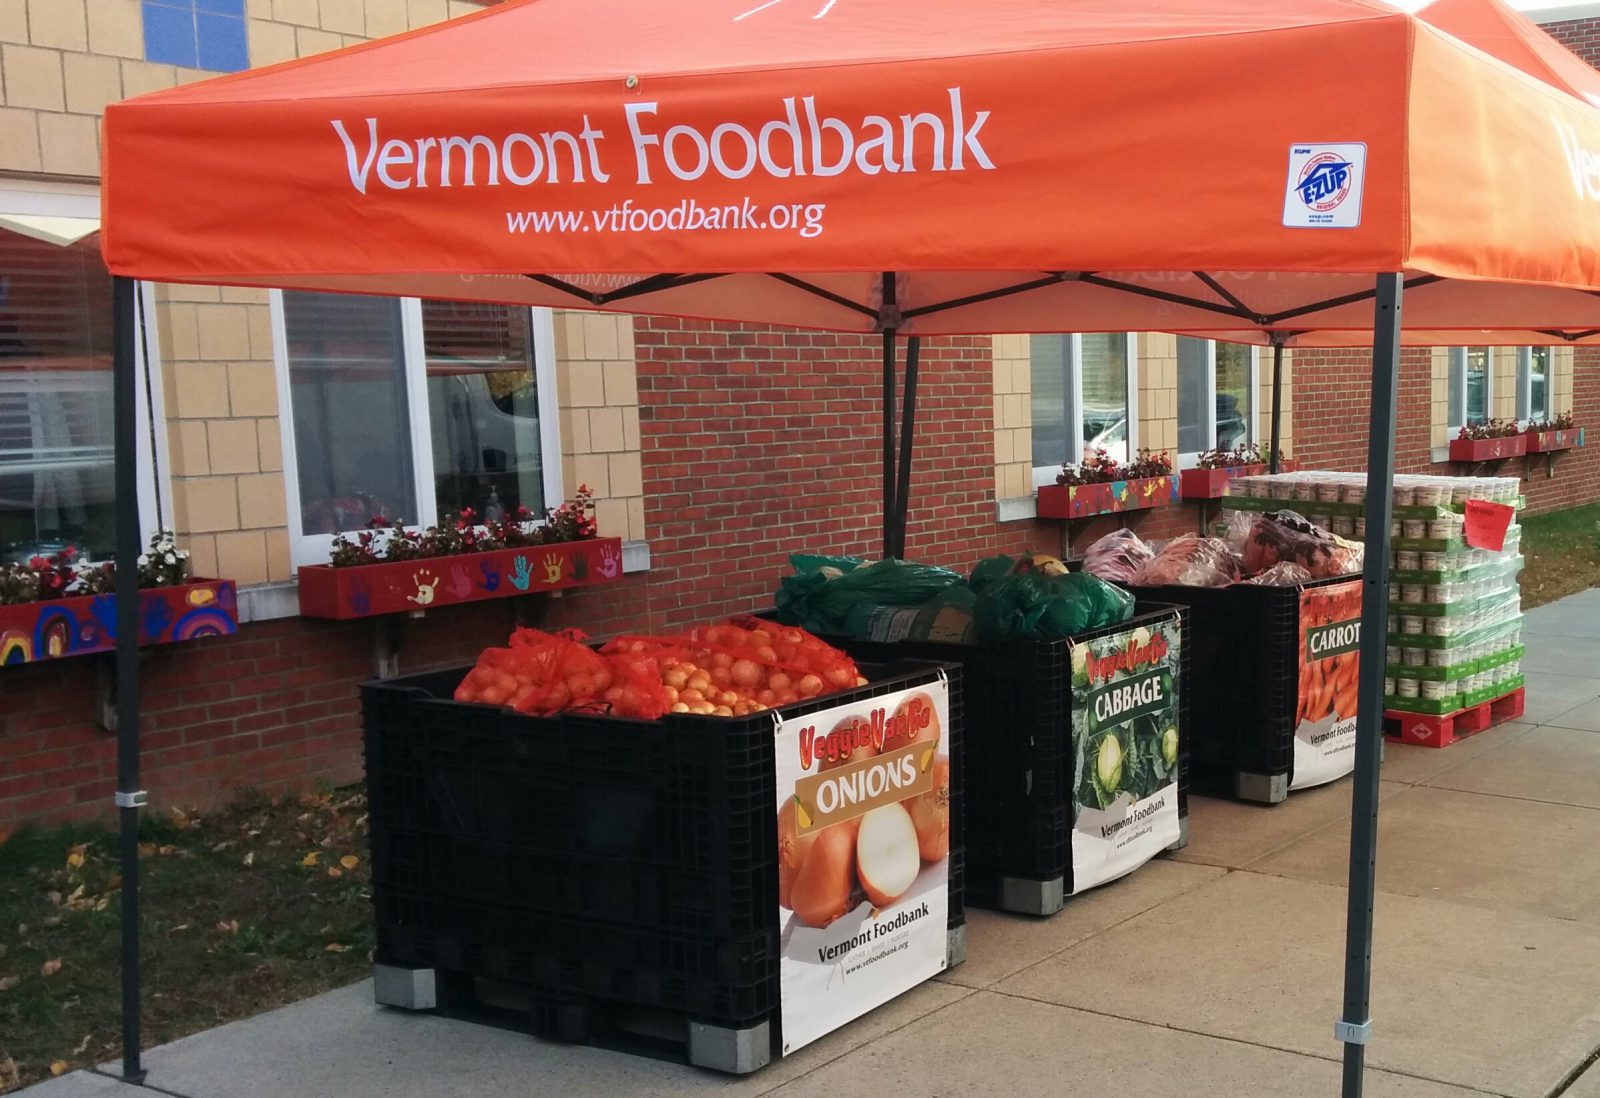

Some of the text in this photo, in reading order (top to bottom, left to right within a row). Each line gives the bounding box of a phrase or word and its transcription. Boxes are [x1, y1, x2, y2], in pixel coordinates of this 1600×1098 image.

[330, 86, 997, 196] Vermont Foodbank
[505, 197, 826, 239] www.vtfoodbank.org
[1310, 622, 1362, 654] CARROT
[1095, 675, 1163, 722] CABBAGE
[1310, 729, 1336, 745] Vermont
[1336, 721, 1357, 737] Foodb
[816, 754, 916, 814] ONIONS
[1101, 815, 1133, 838] Vermont
[1133, 795, 1165, 822] Foodbank
[818, 902, 929, 963] Vermont Foodbank
[845, 941, 909, 975] www.vtfoodbank.org
